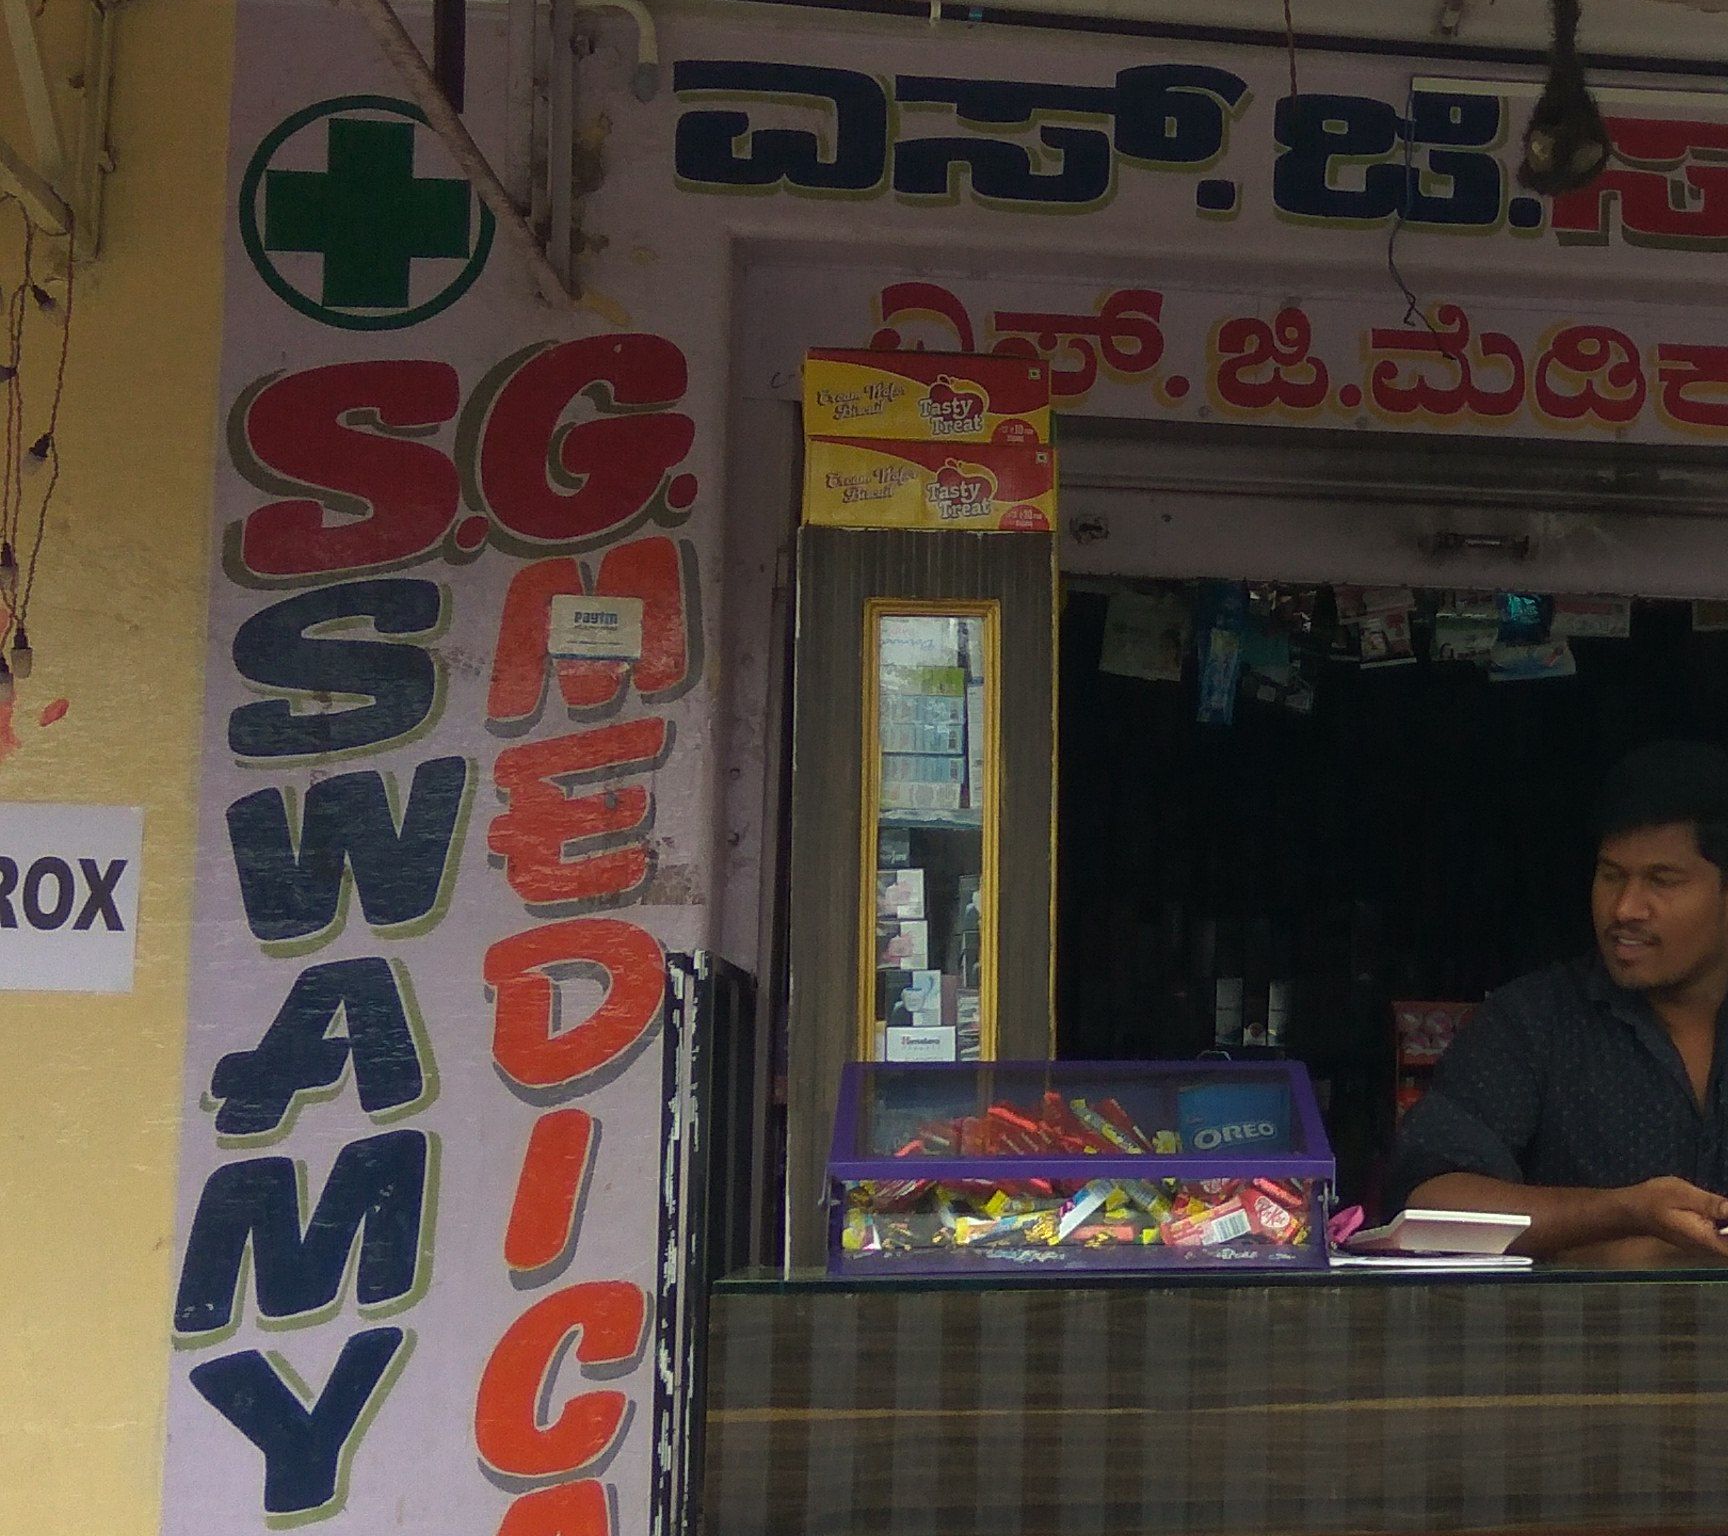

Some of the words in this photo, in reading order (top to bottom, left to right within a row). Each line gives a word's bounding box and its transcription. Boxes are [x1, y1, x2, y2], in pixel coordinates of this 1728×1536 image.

[919, 397, 974, 419] Tasty
[930, 415, 985, 435] Treat
[927, 481, 981, 503] Tasty
[939, 499, 992, 520] Treat
[1192, 1120, 1276, 1151] OREO
